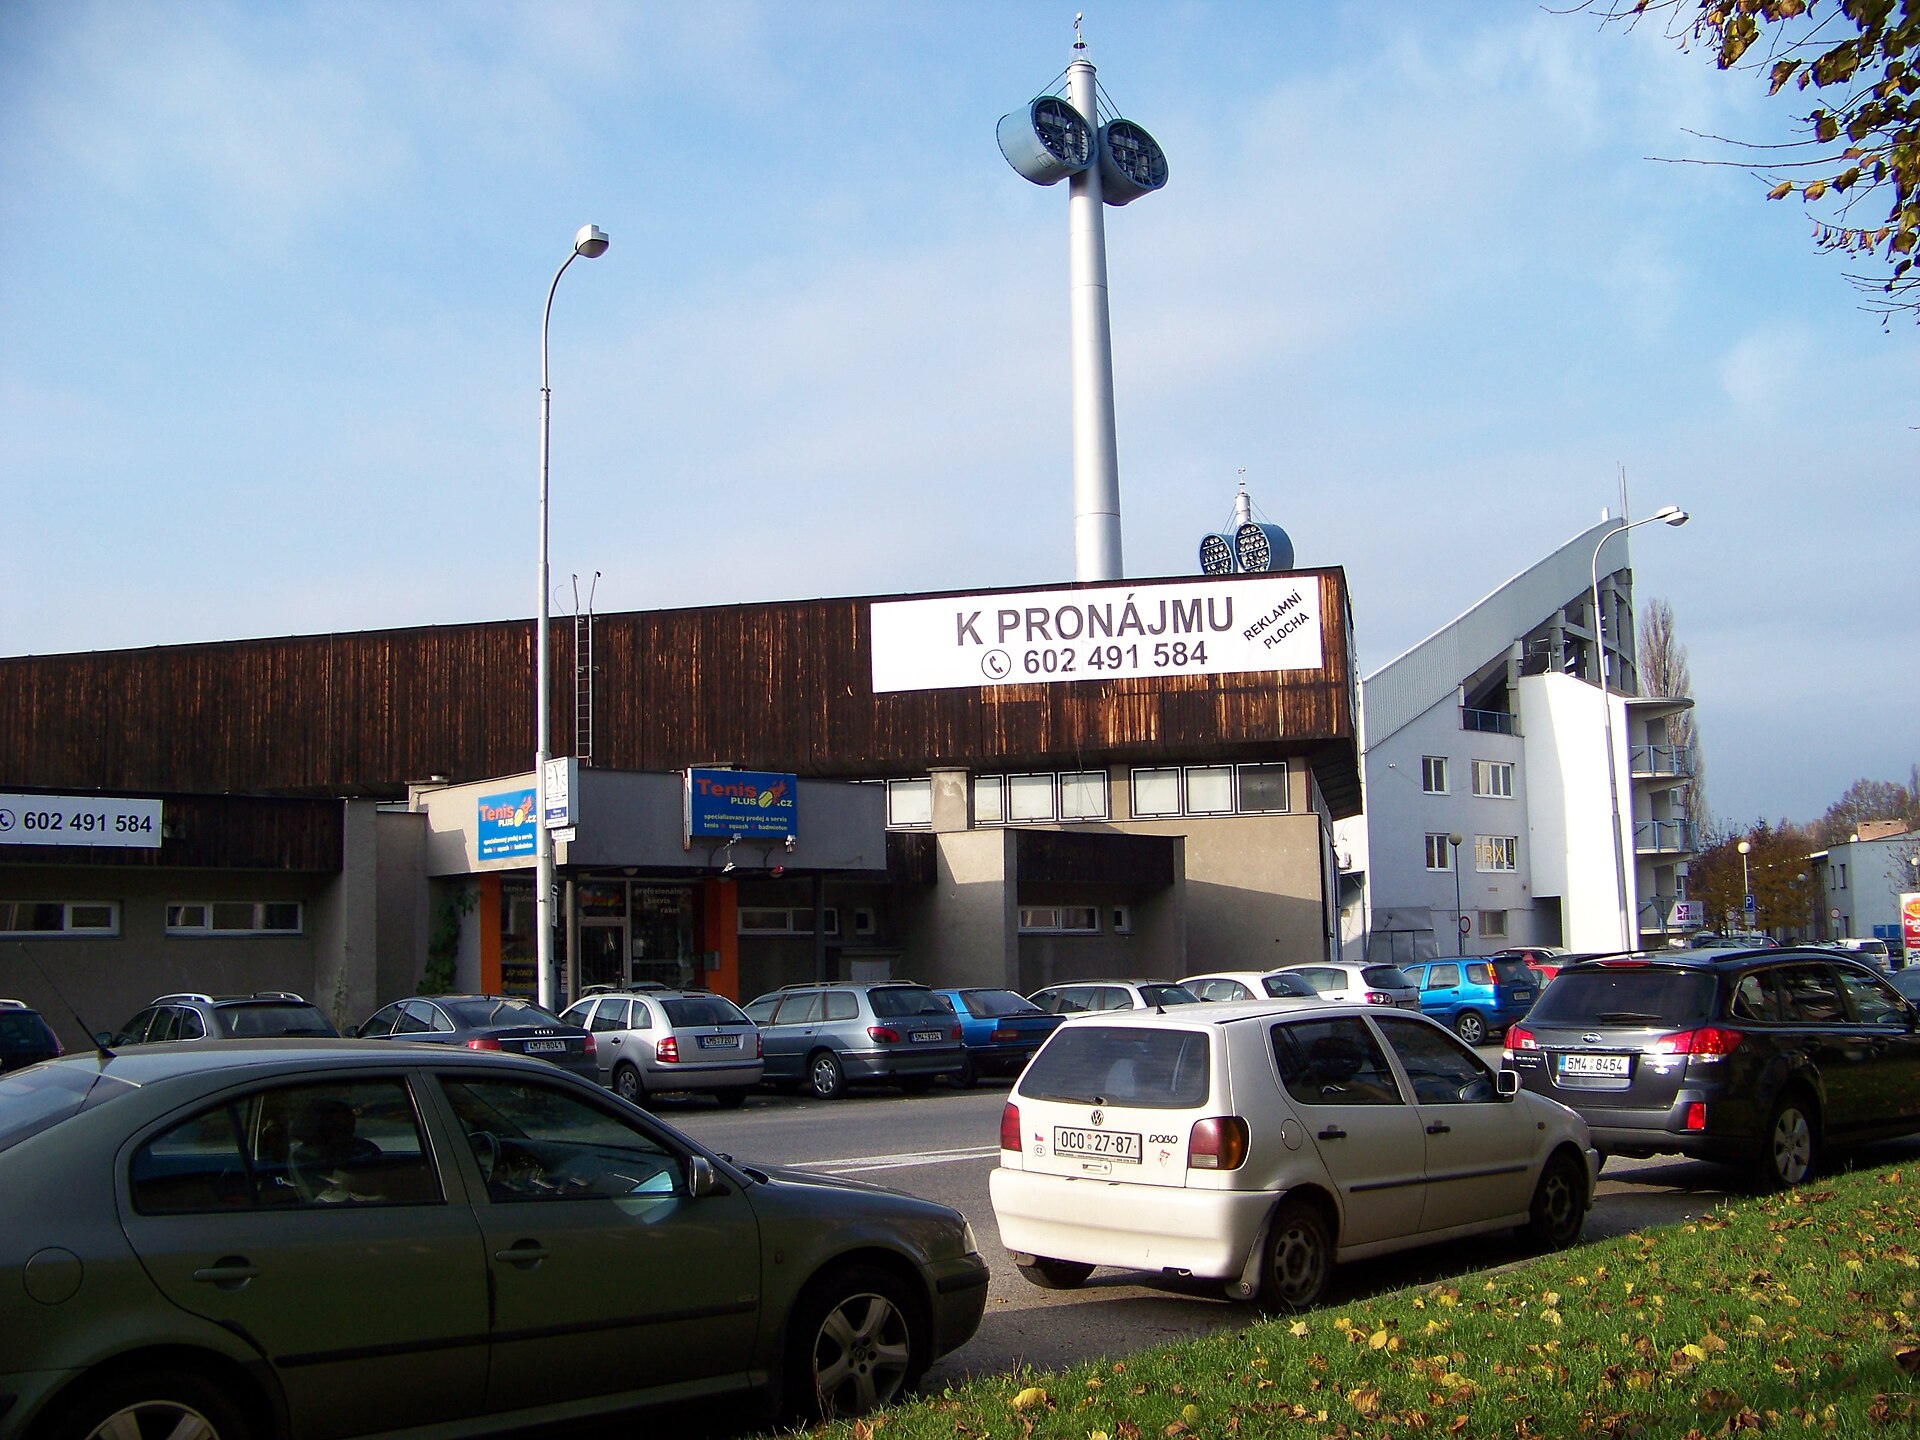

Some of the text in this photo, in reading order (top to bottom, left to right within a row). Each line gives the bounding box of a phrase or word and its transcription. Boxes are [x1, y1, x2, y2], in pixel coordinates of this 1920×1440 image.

[957, 593, 1233, 646] K PRONÁJMU
[1243, 589, 1303, 641] REKLAMNÍ
[1263, 612, 1309, 650] PLOCHA
[1024, 641, 1208, 674] 602 491 584
[696, 778, 757, 798] Tenis
[730, 797, 757, 805] PLUS
[24, 811, 152, 833] 602 491 584
[480, 804, 514, 822] Tenis
[498, 817, 514, 827] PLUS
[703, 813, 745, 821] specializovaný
[745, 815, 765, 823] prodej
[1474, 844, 1505, 863] TRX
[1567, 1057, 1623, 1072] 5M4 8454
[1094, 1134, 1133, 1154] 27-87
[1149, 1134, 1178, 1144] POLO
